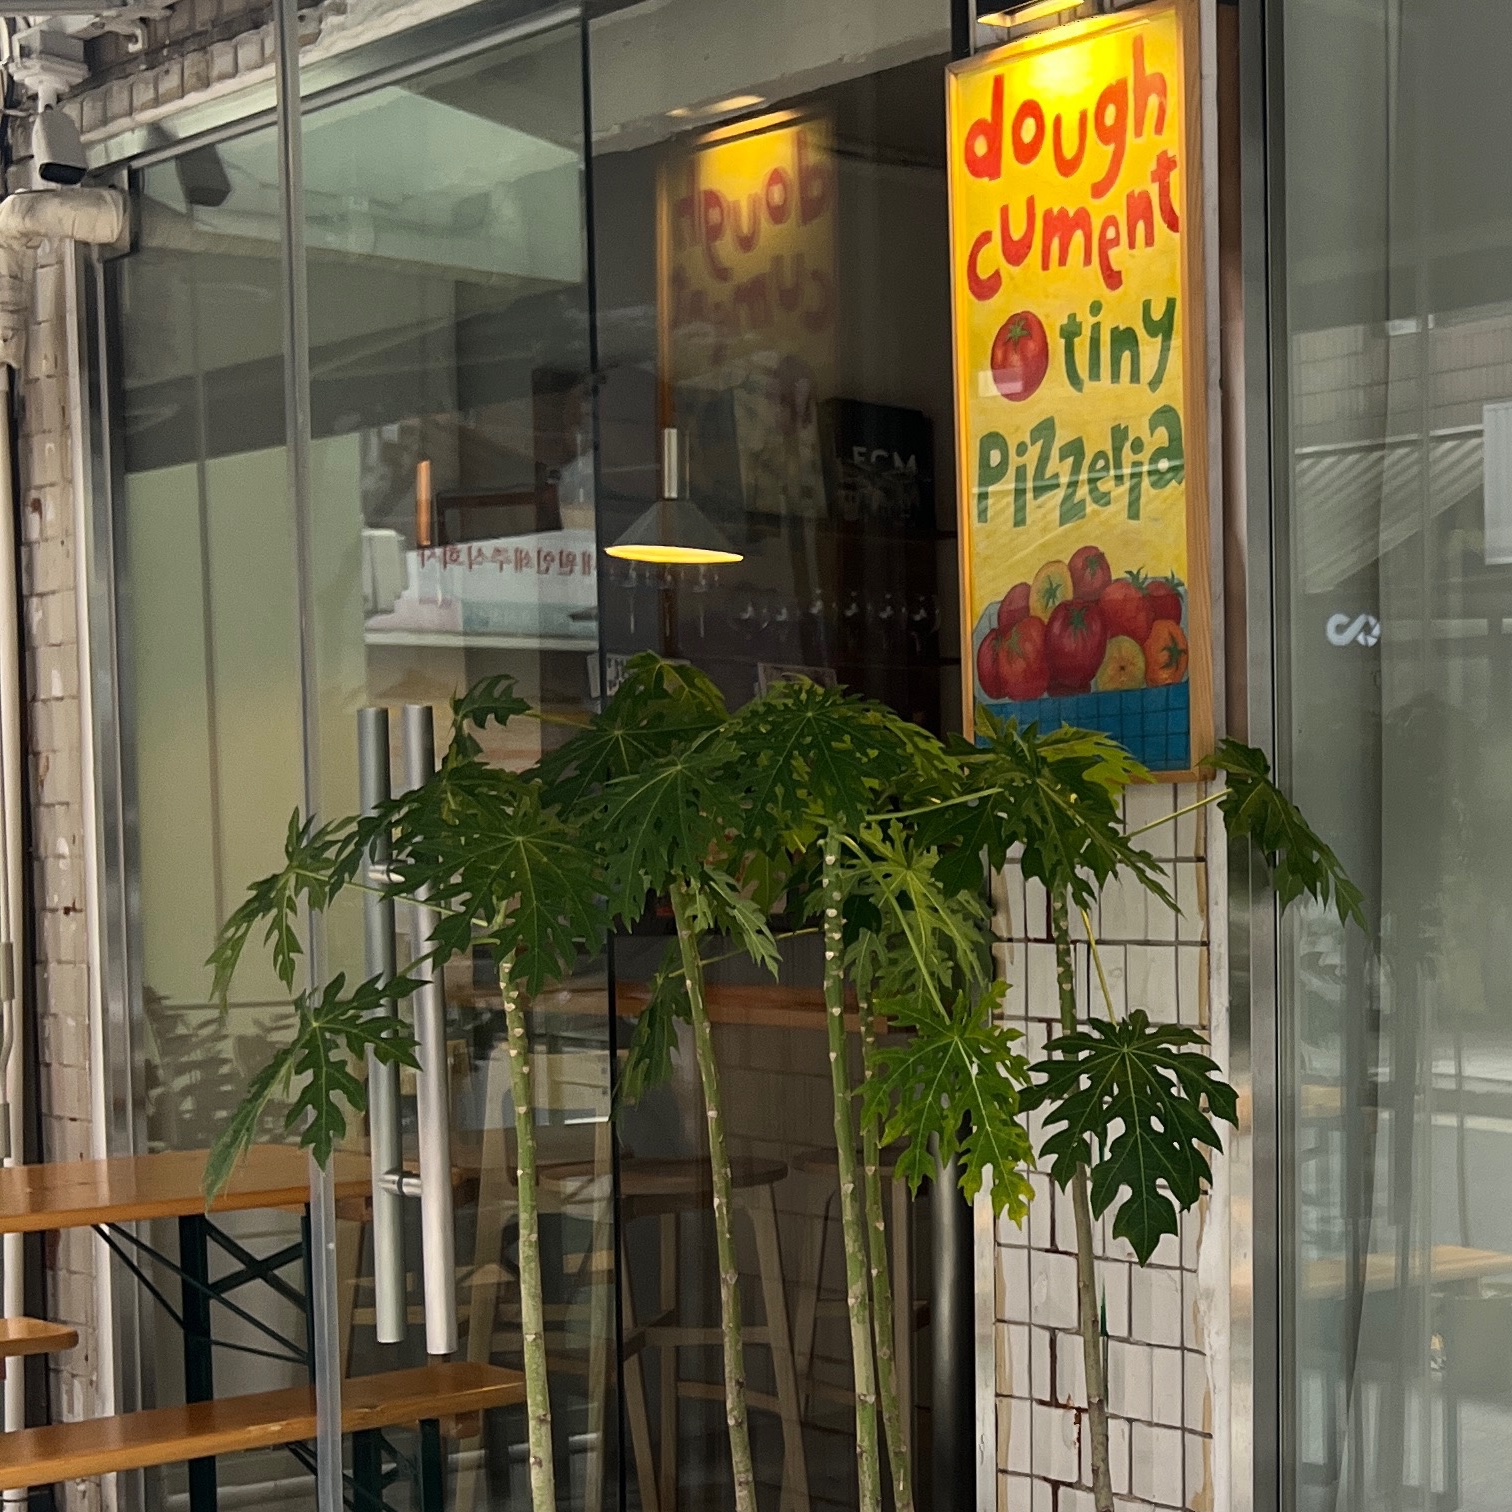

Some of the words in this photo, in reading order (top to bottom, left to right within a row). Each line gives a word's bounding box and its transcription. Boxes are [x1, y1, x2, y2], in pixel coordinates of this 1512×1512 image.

[964, 34, 1168, 200] dough
[966, 149, 1180, 302] cument
[1059, 296, 1178, 394] tiny
